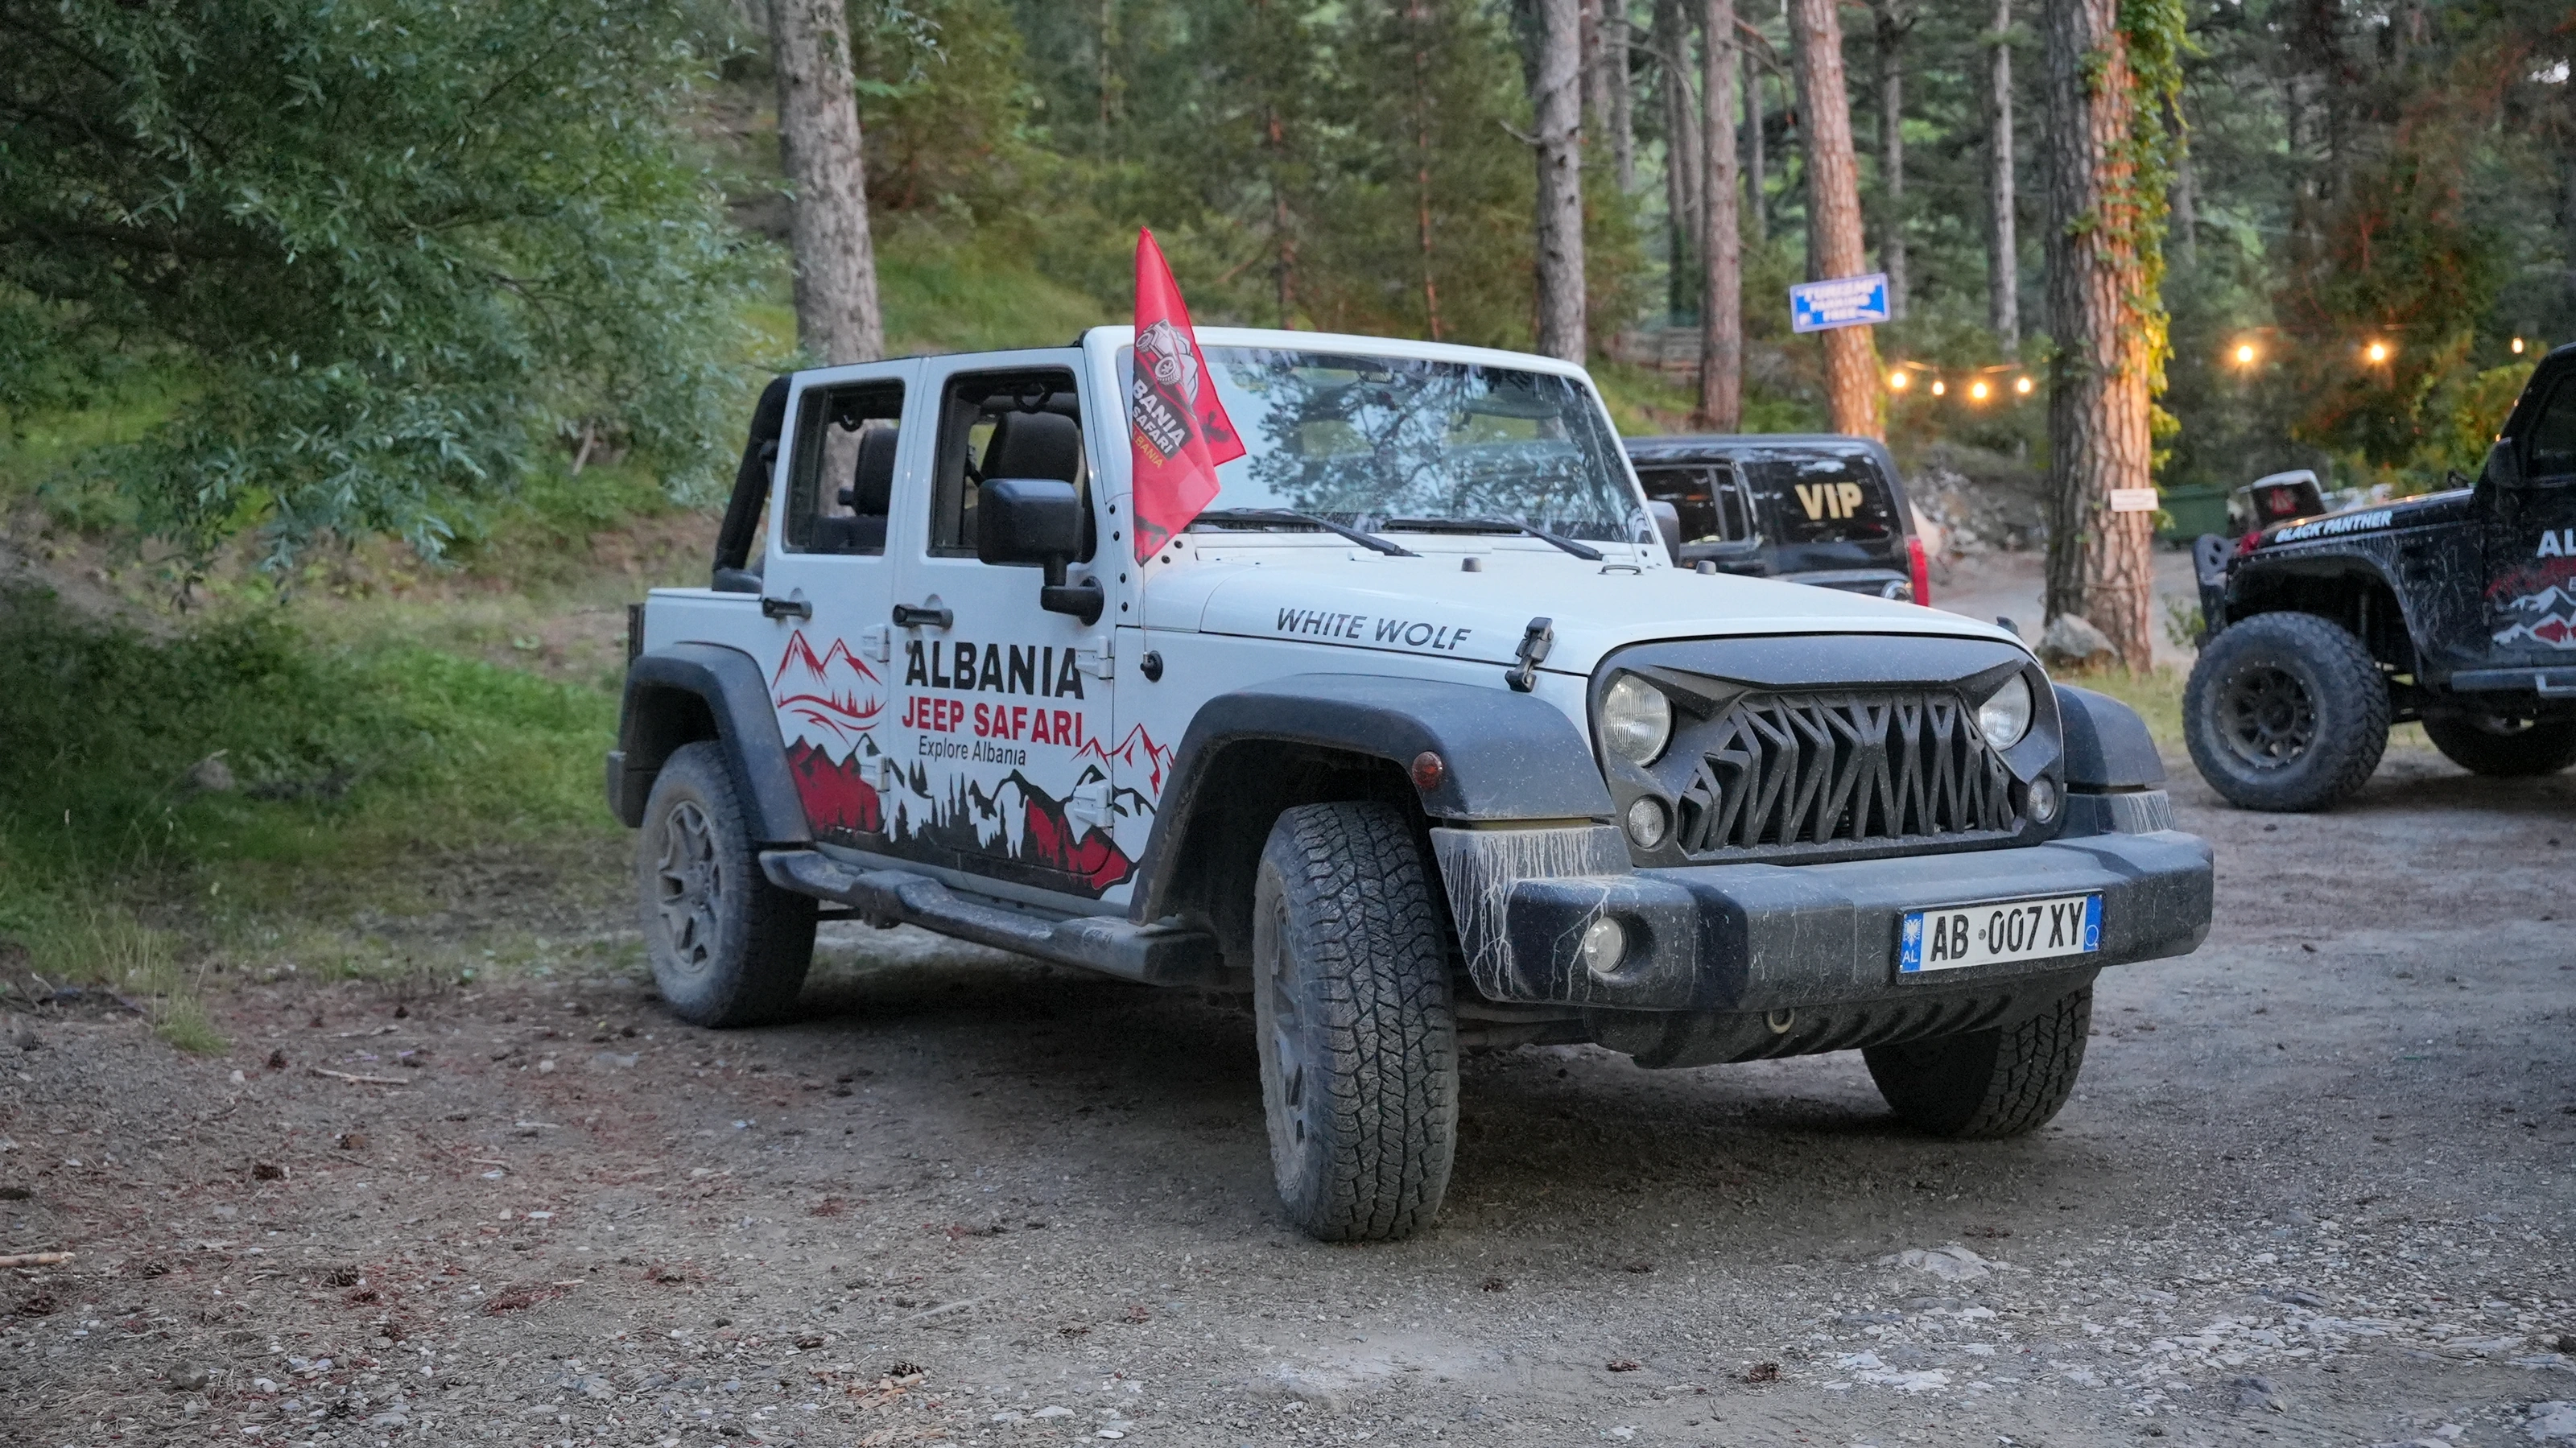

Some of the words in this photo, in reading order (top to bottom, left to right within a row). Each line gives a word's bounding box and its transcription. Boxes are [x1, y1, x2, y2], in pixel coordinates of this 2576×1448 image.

[1133, 406, 1173, 454] SAFARI
[1794, 482, 1864, 521] VIP
[2274, 523, 2324, 543] BLACK
[2323, 509, 2393, 535] PANTHER
[1277, 608, 1367, 639] WHITE
[1375, 618, 1472, 650] WOLF
[905, 640, 1085, 700] ALBANIA
[902, 695, 964, 733] JEEP
[973, 703, 1082, 748] SAFARI
[919, 735, 968, 762] Explore
[972, 741, 1026, 765] Albania
[1930, 914, 1969, 963] AB
[1988, 905, 2044, 955] 007
[2048, 901, 2084, 948] XY
[1902, 950, 1919, 963] AL
